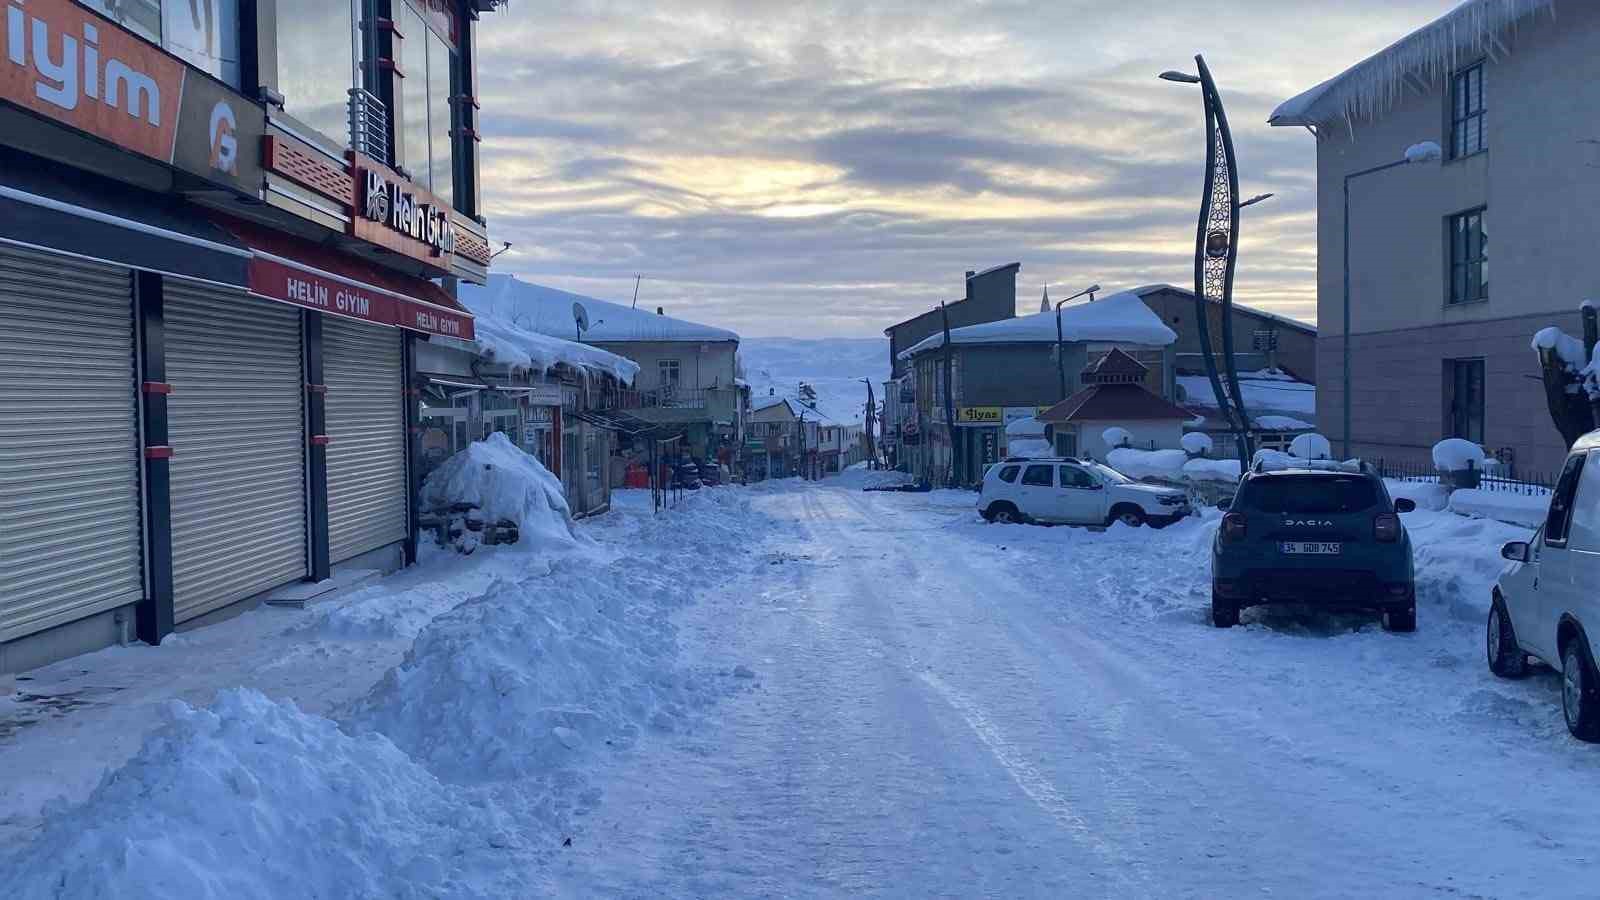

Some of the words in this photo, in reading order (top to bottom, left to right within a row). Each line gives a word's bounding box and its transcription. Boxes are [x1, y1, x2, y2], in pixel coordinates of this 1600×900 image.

[393, 184, 424, 241] Helin
[287, 278, 328, 306] HELİN
[336, 289, 369, 315] GİYİM
[1285, 519, 1332, 527] DACIA
[1321, 543, 1339, 553] 745
